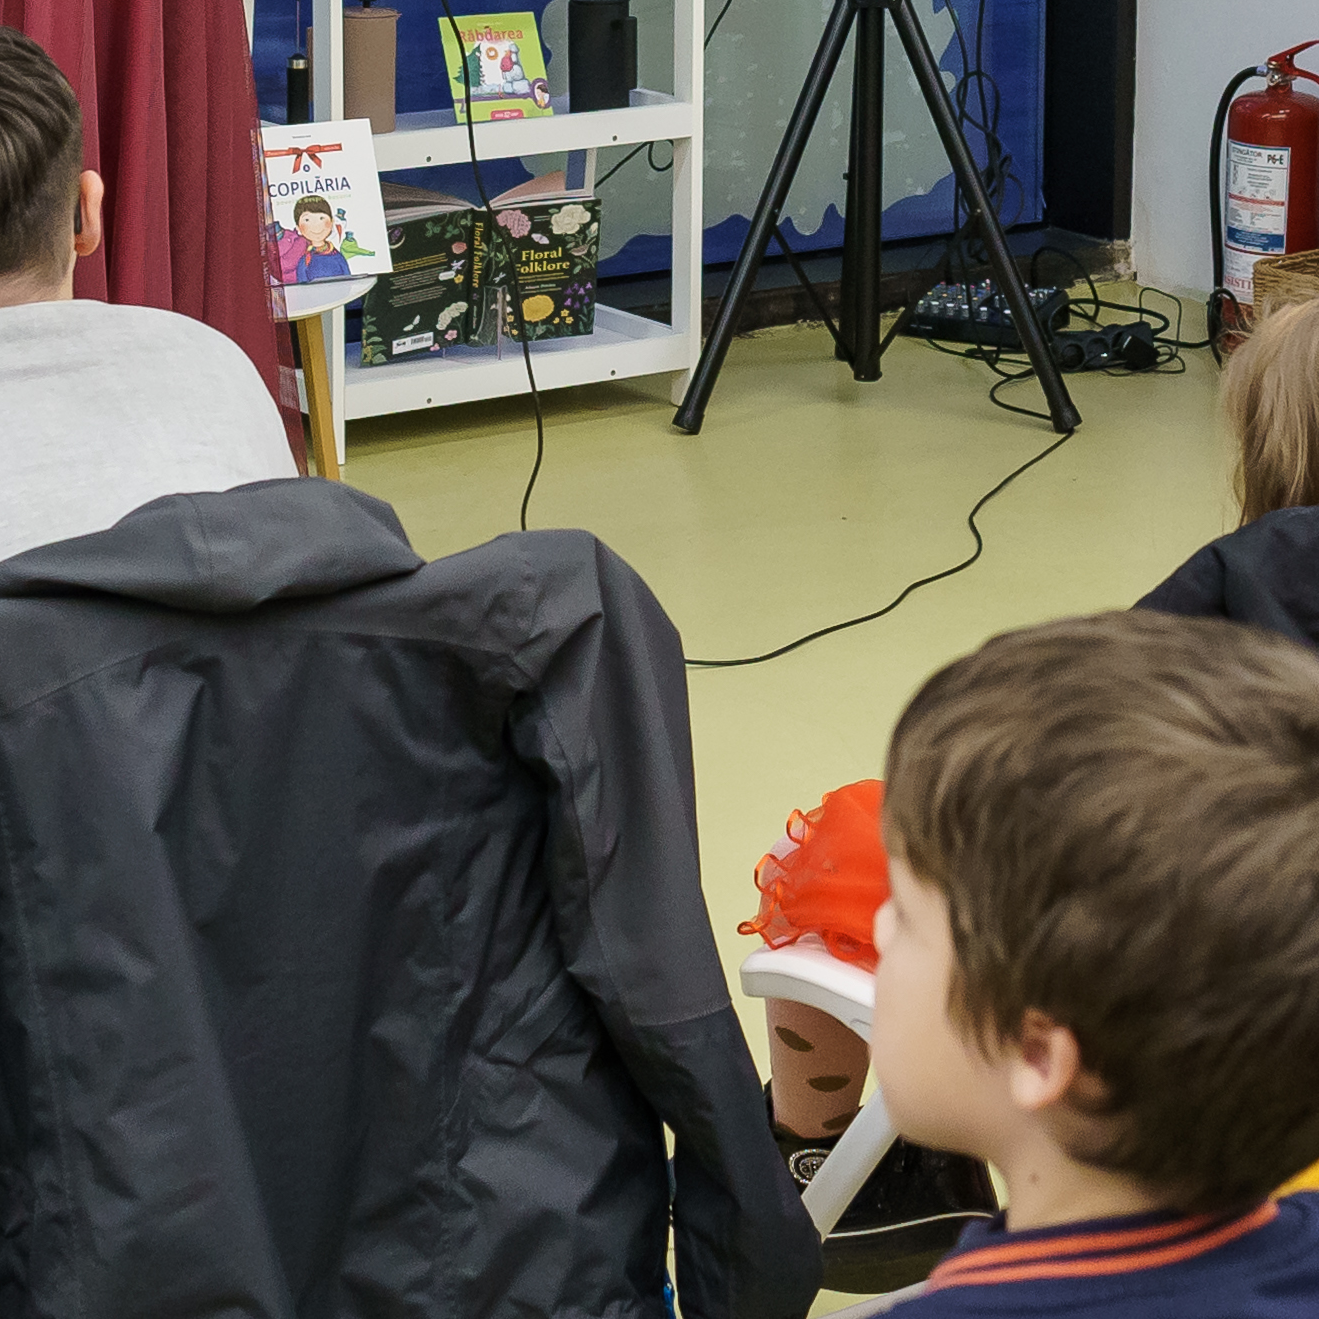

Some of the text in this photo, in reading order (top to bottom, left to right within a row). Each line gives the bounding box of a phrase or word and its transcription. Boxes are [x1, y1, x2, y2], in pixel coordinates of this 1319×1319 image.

[269, 176, 351, 198] COPILĂRIA
[472, 222, 484, 288] Floral Folklore
[521, 247, 563, 261] Floral
